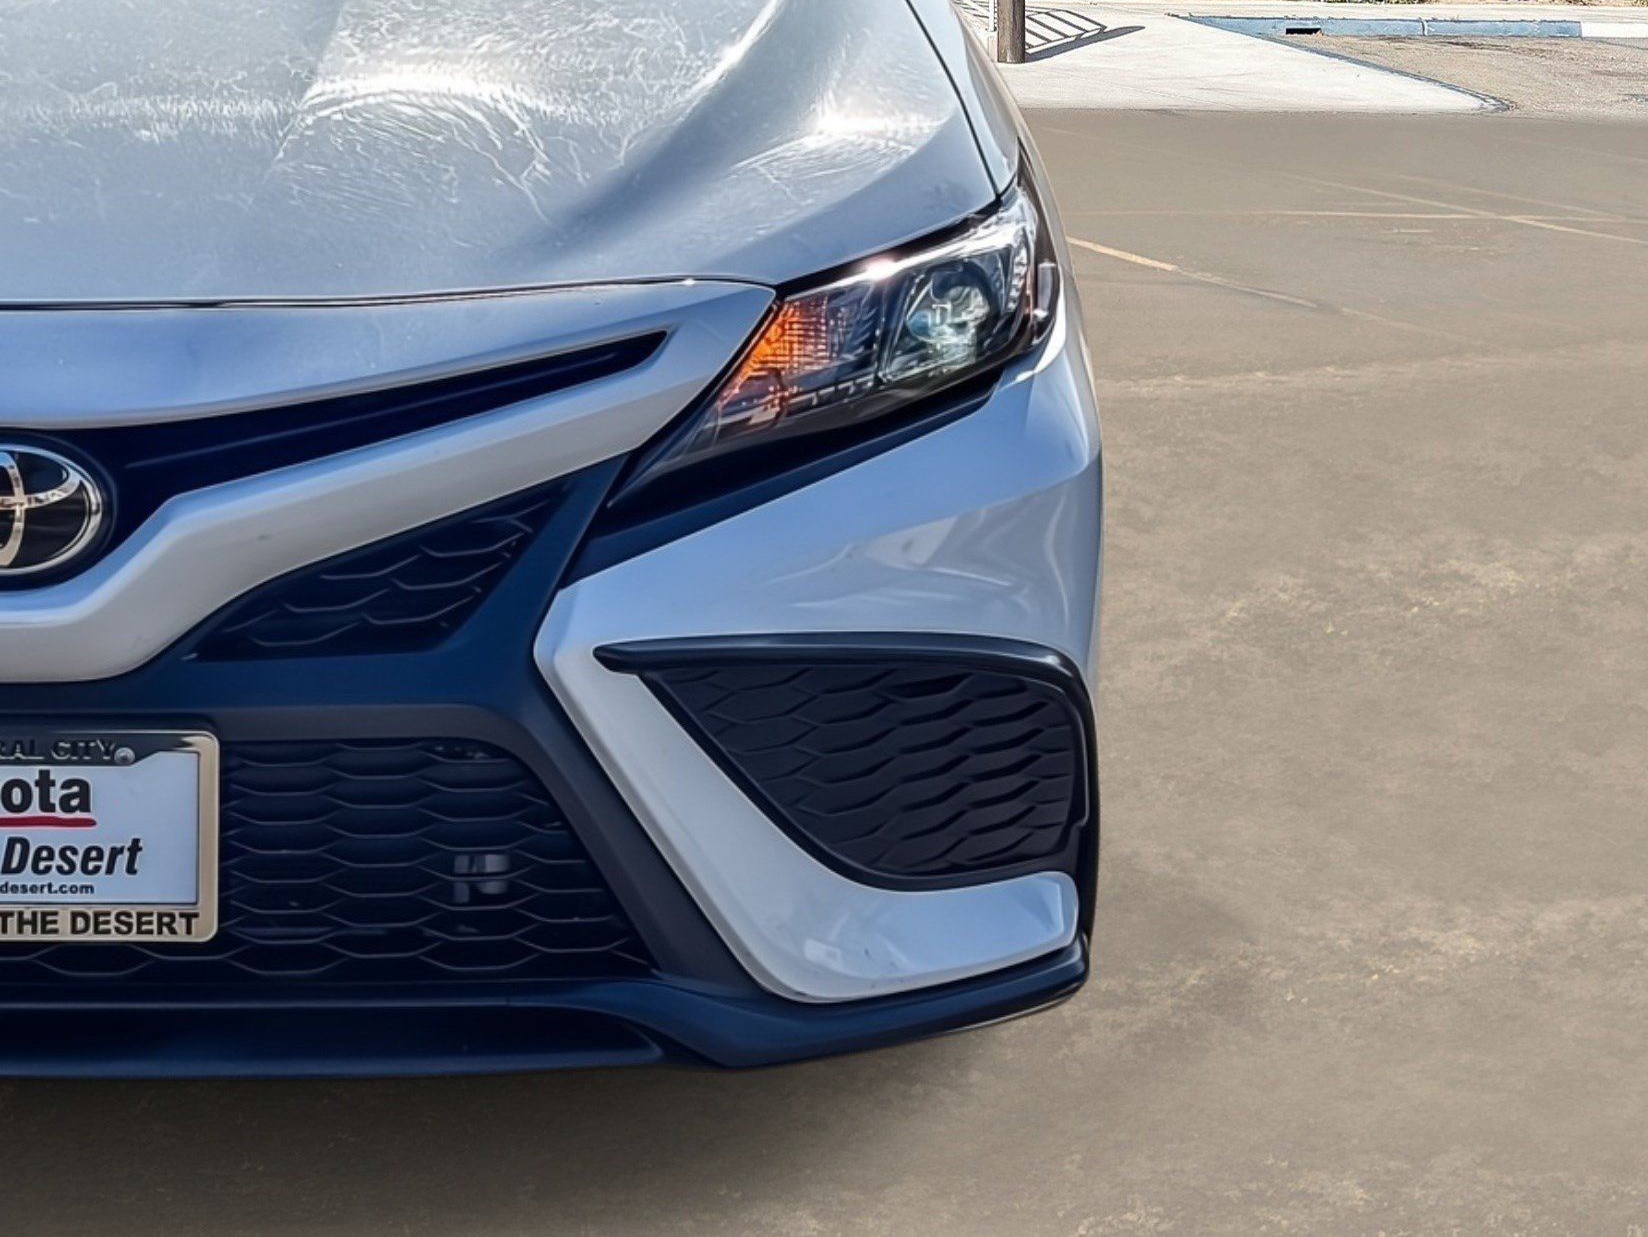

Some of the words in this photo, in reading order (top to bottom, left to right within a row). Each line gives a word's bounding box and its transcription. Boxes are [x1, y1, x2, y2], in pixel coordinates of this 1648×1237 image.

[52, 739, 115, 761] CITY
[1, 837, 143, 877] Desert
[69, 910, 200, 936] DESERT
